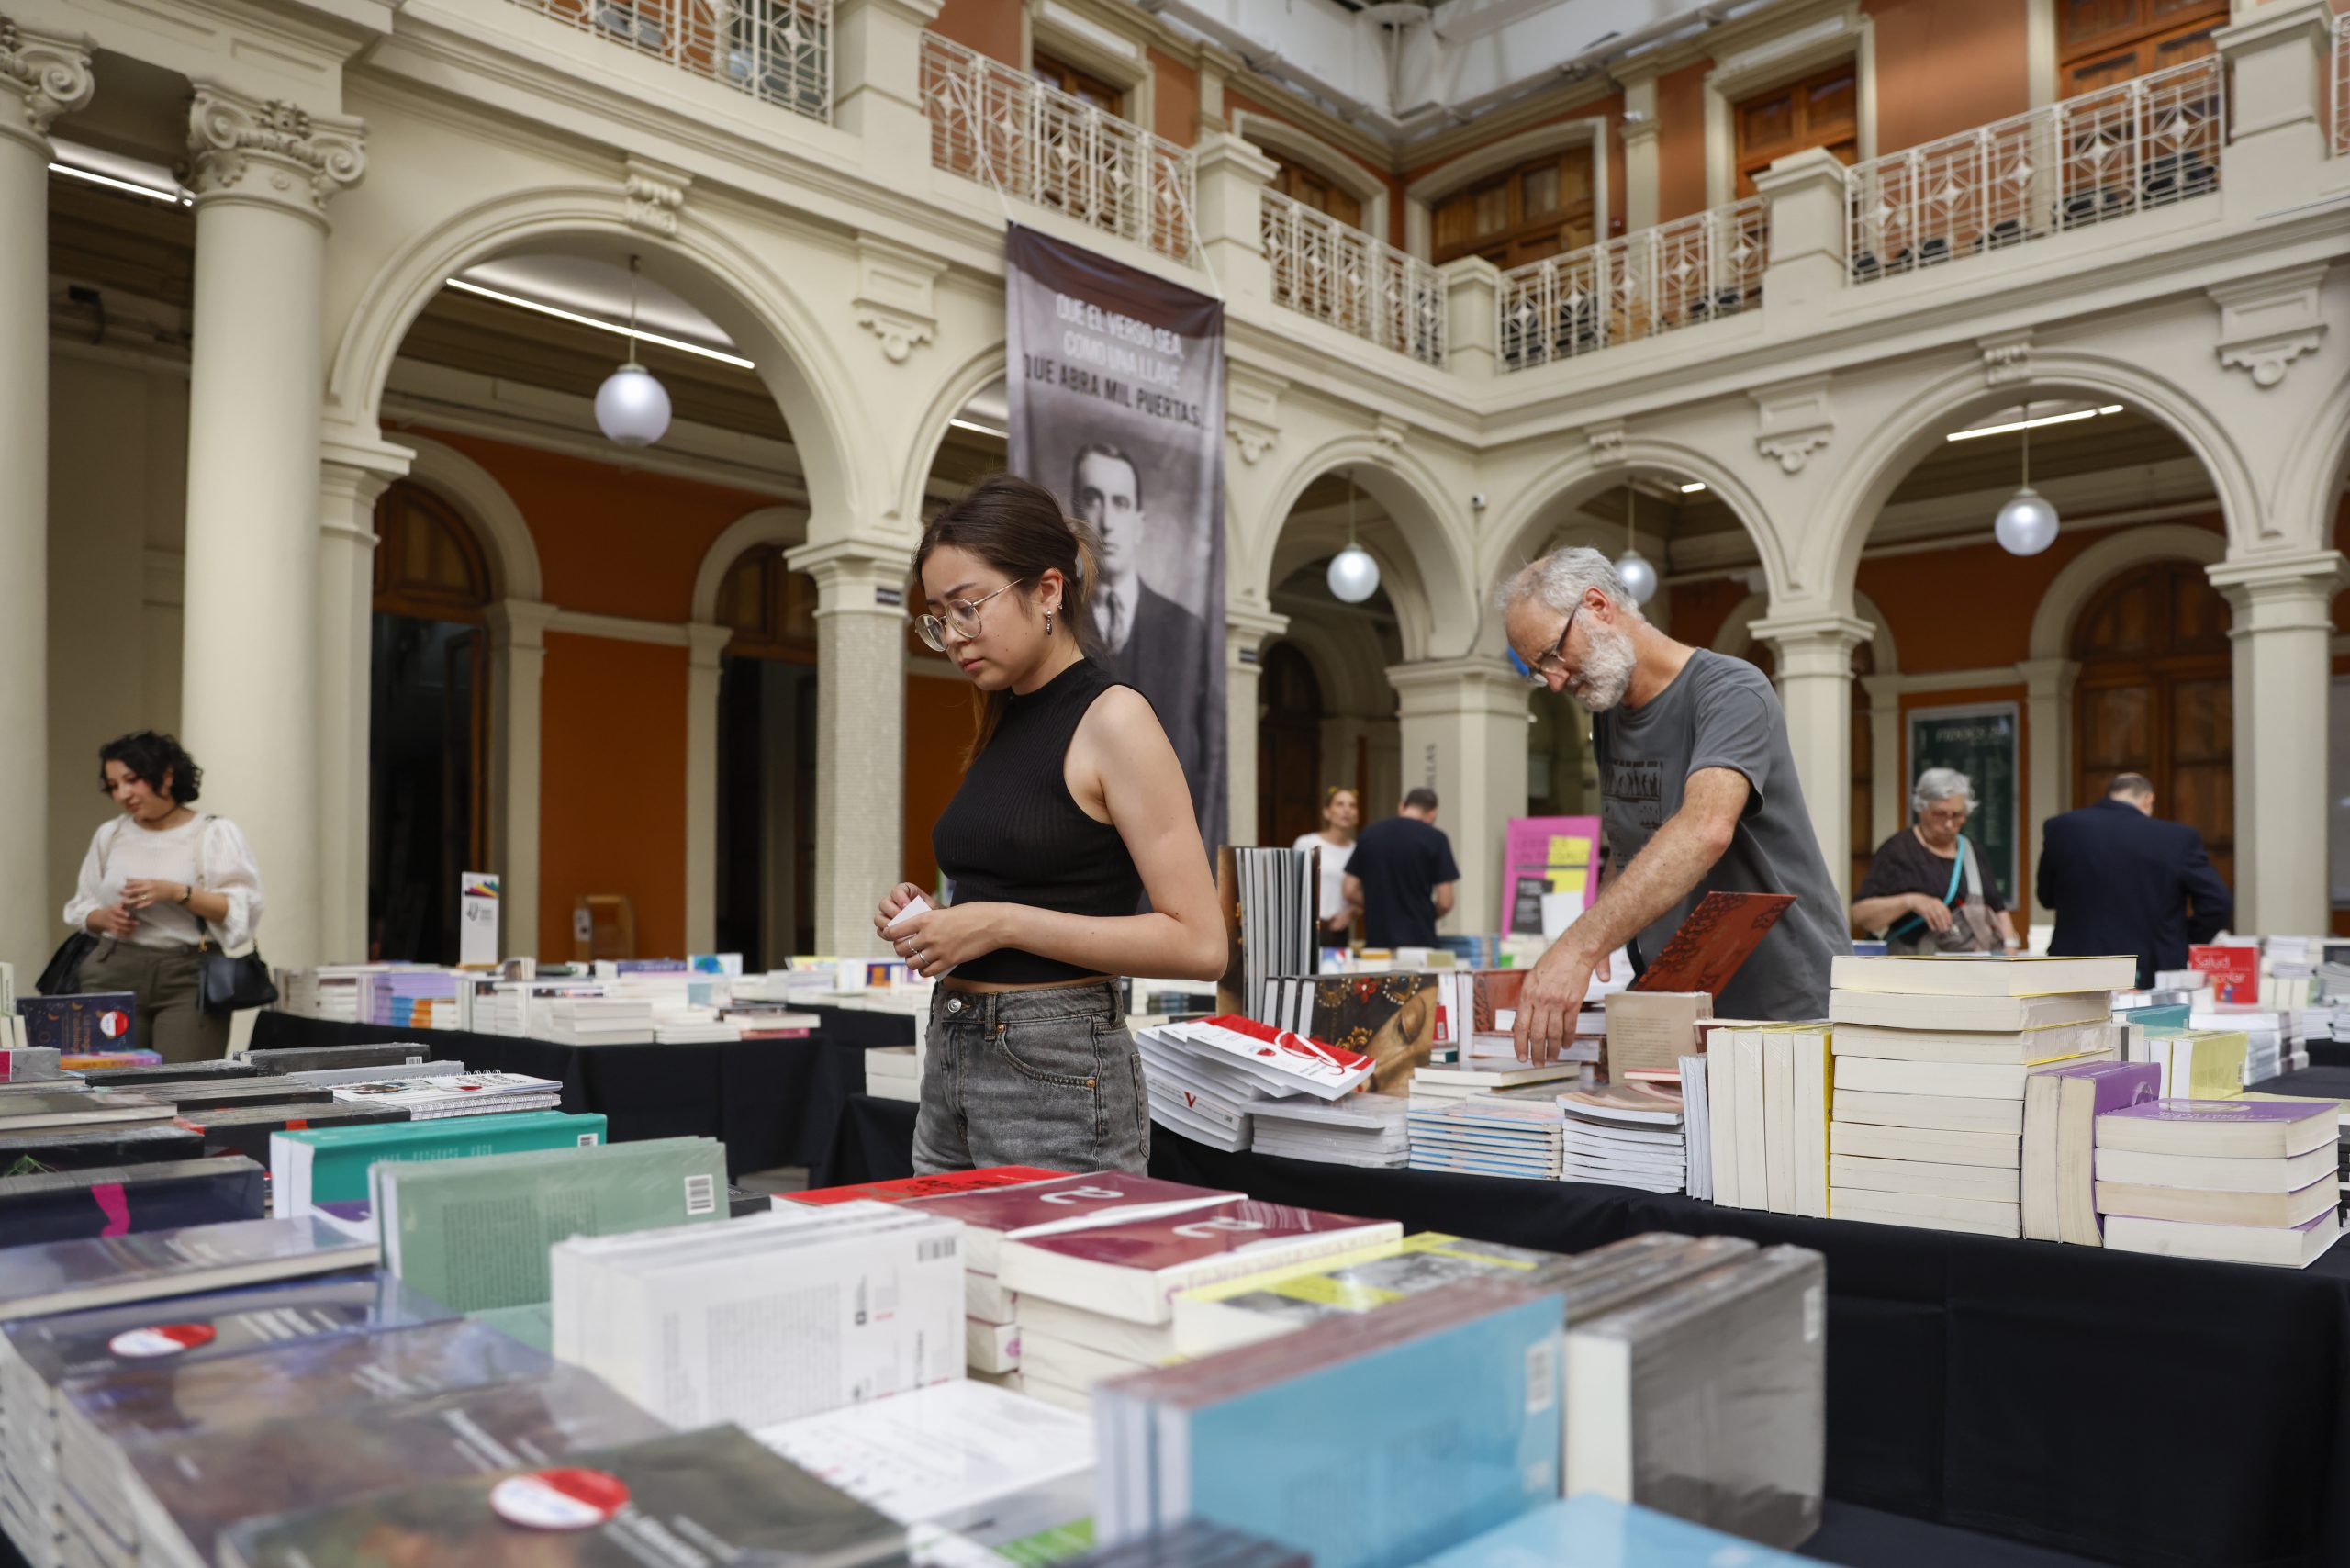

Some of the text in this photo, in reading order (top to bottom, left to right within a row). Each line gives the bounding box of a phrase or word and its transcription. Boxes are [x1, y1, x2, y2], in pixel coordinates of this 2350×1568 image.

[1064, 330, 1107, 366] COMO
[1106, 310, 1153, 349] VERSO
[1059, 364, 1100, 397] ABRA
[1104, 378, 1131, 408] MIL
[2194, 954, 2230, 969] Salud
